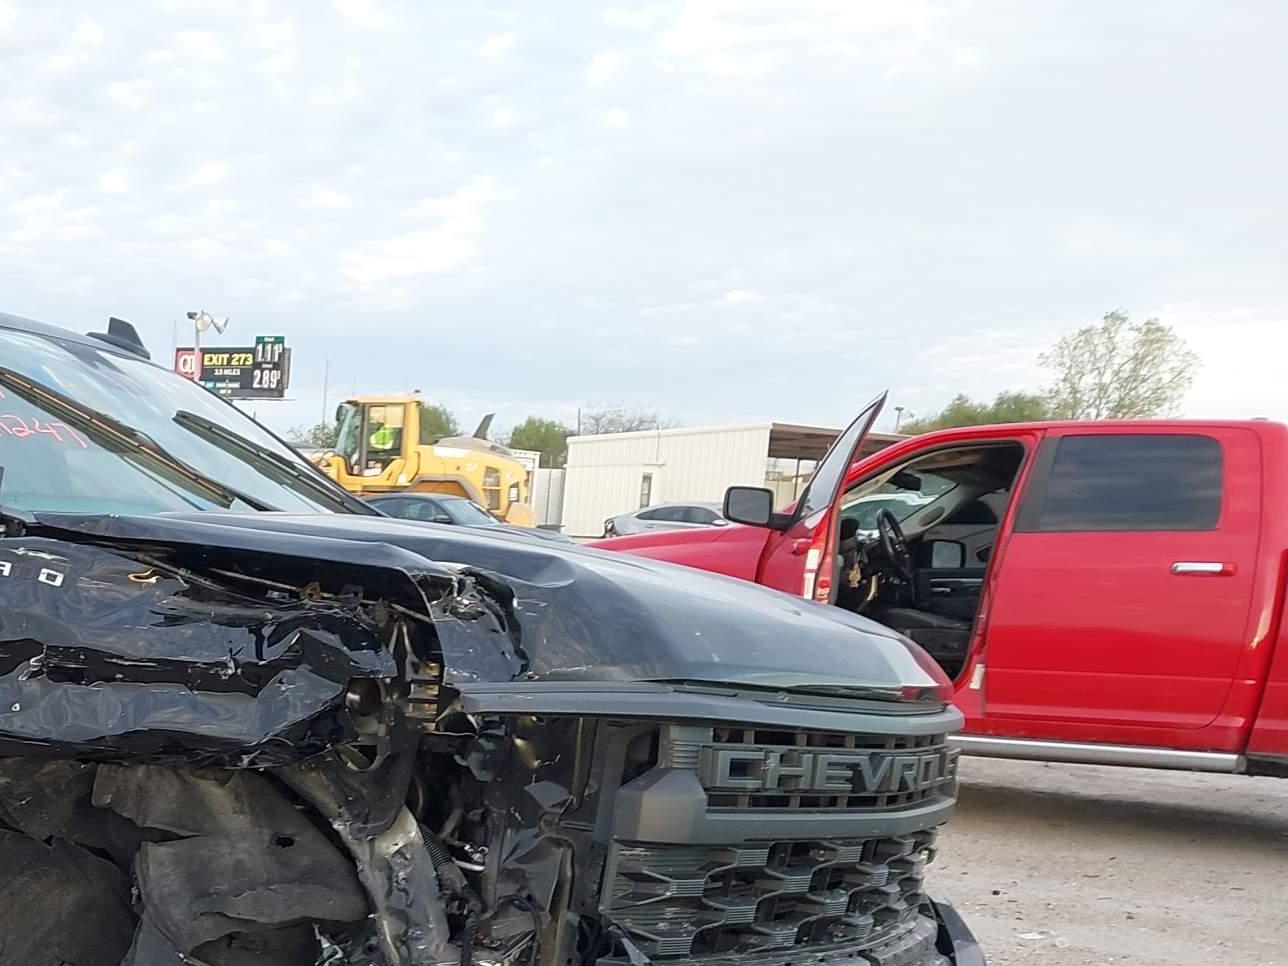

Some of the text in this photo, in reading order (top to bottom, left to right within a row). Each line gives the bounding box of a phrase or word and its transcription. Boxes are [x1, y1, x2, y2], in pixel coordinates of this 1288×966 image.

[203, 353, 254, 366] EXIT 273
[224, 368, 241, 376] MILES
